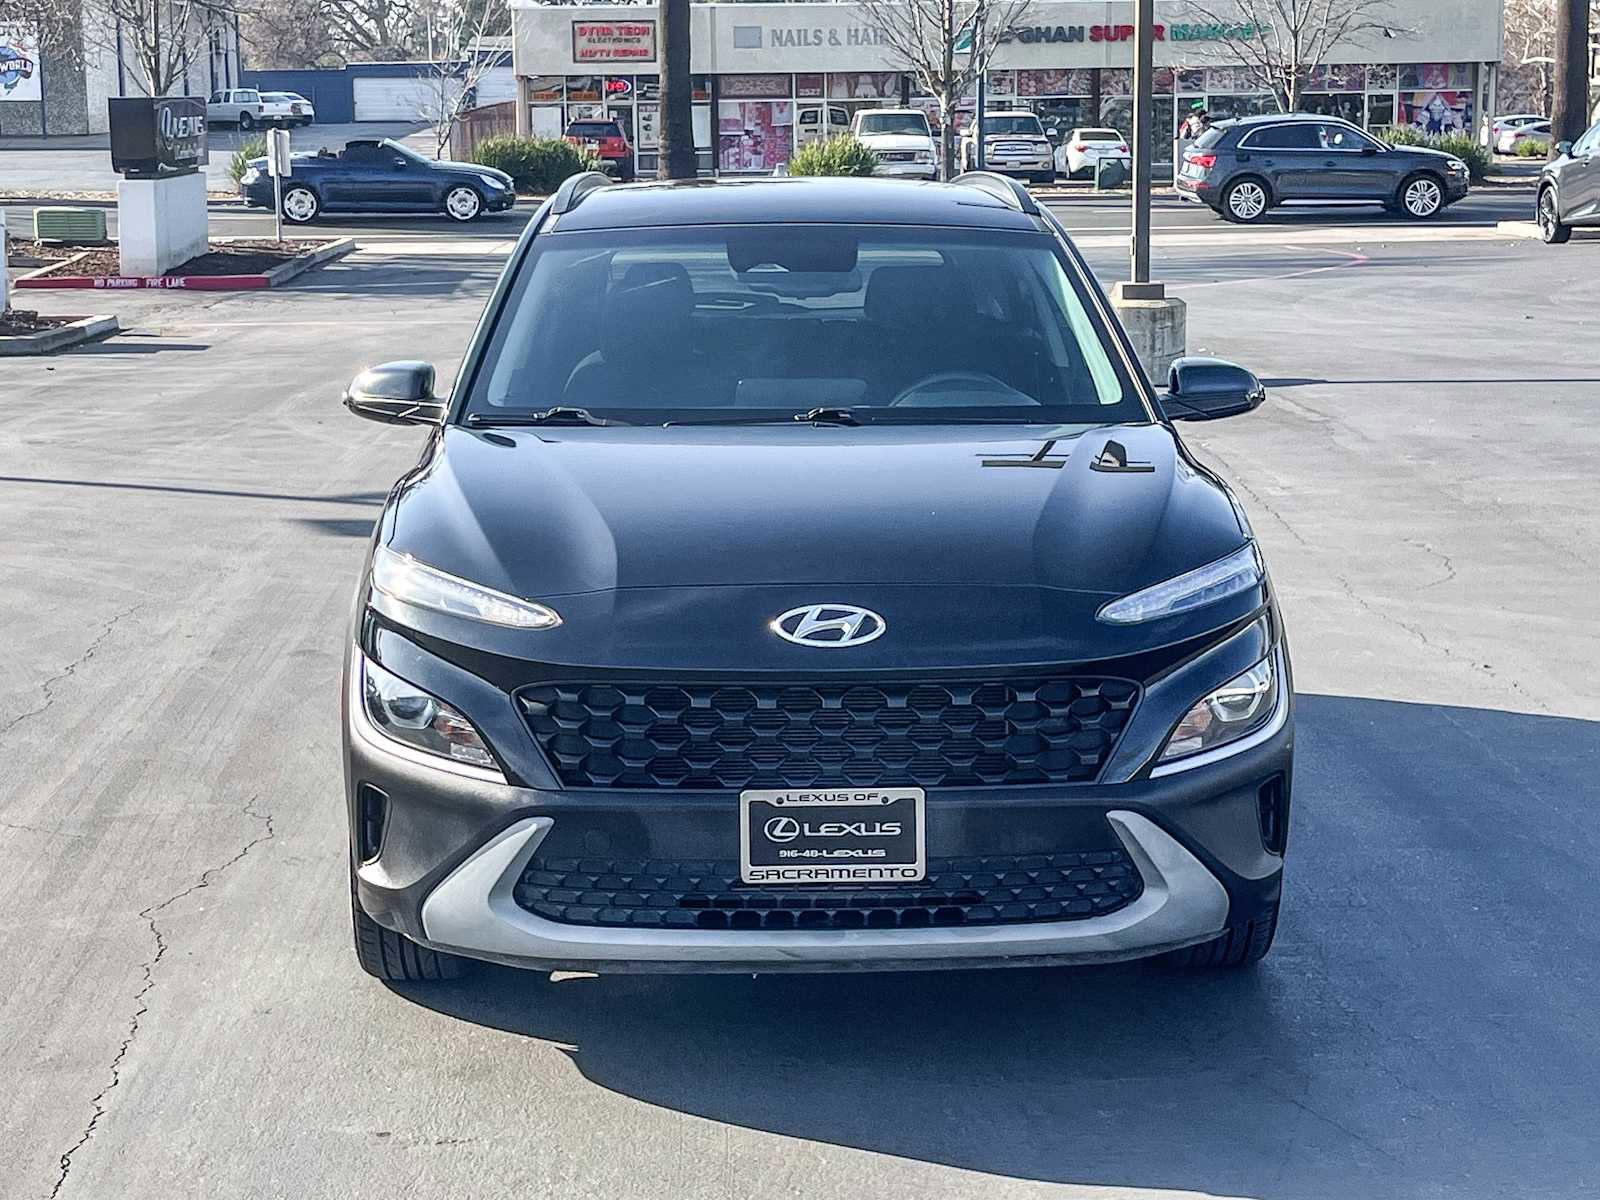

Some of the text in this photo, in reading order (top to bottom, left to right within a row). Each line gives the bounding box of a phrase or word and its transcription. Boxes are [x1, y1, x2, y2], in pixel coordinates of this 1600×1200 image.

[771, 29, 823, 47] NAILS
[828, 28, 842, 46] &
[998, 26, 1085, 43] GHAN
[1089, 25, 1165, 42] SUPR
[94, 277, 187, 288] NO PARKING FIRE LANE
[786, 792, 879, 802] LEXUS OF
[803, 822, 901, 836] LEXUS
[779, 849, 886, 858] 916-48-LEXUS
[749, 868, 918, 881] SACRAMENTO
